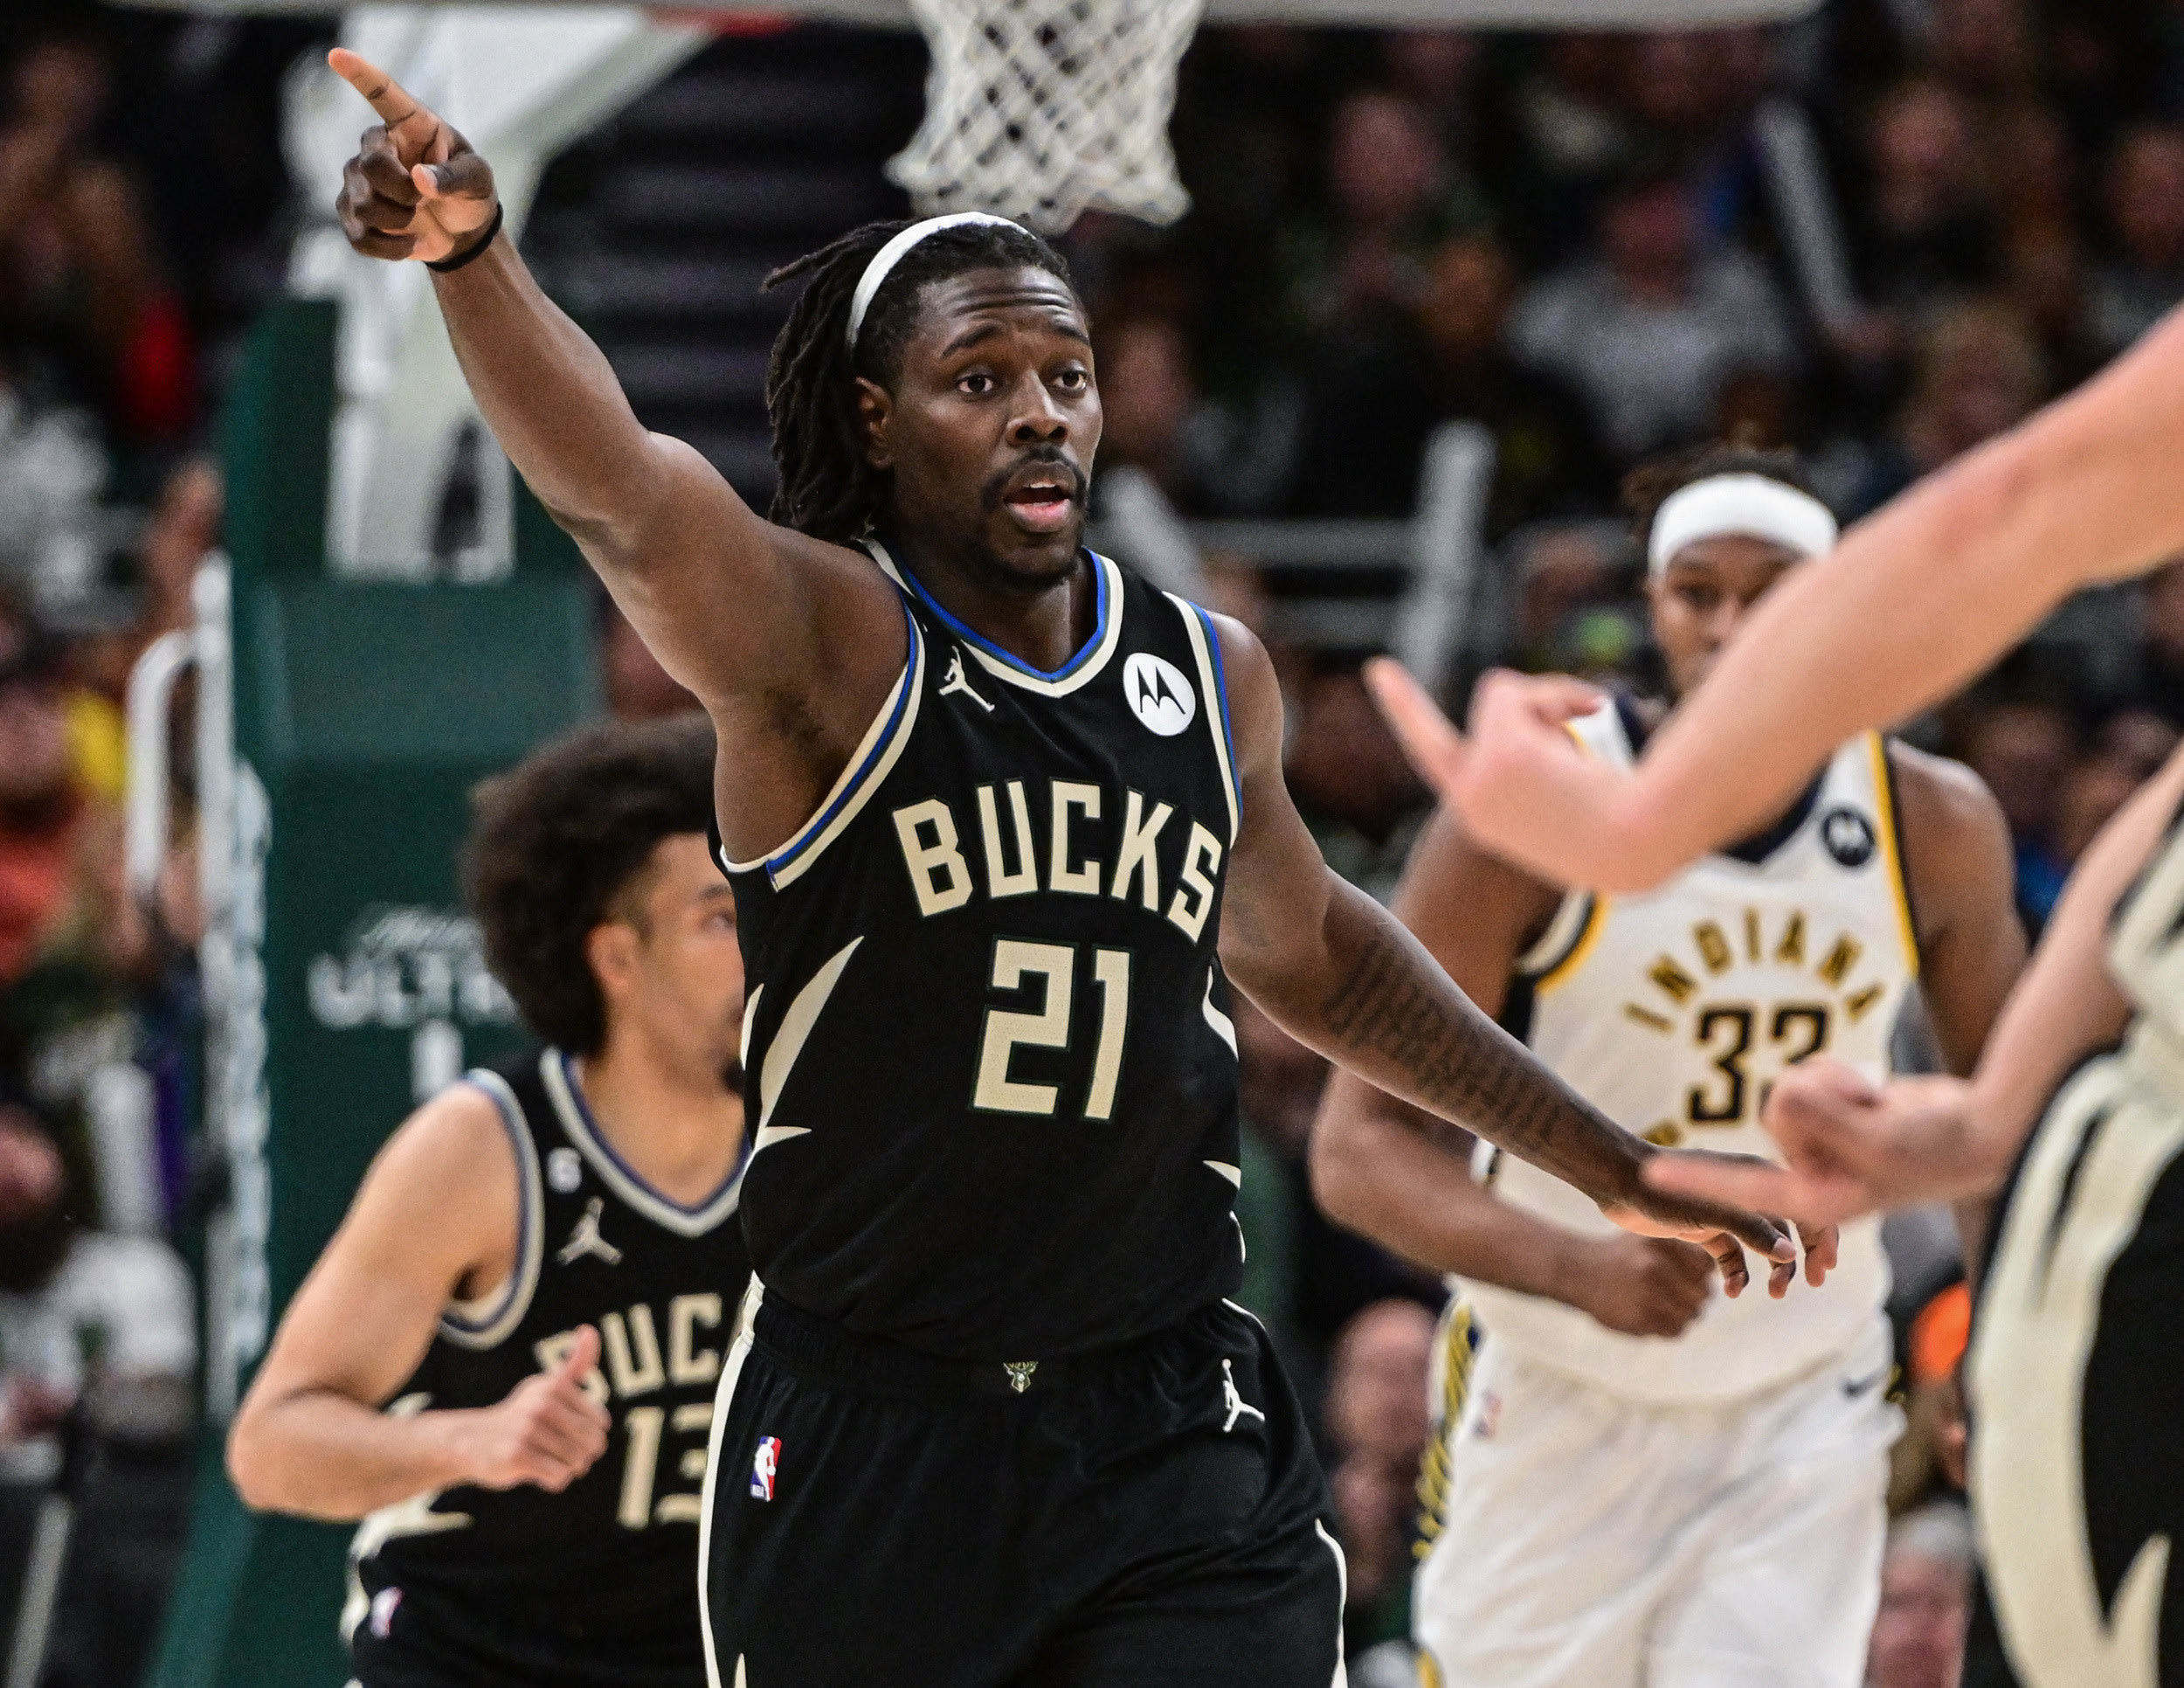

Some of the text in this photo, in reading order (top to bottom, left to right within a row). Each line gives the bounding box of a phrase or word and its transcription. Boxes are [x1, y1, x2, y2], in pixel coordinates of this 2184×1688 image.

[891, 779, 1223, 944] BUCKS
[971, 937, 1132, 1122] 21
[1622, 904, 1885, 1034] INDIANA
